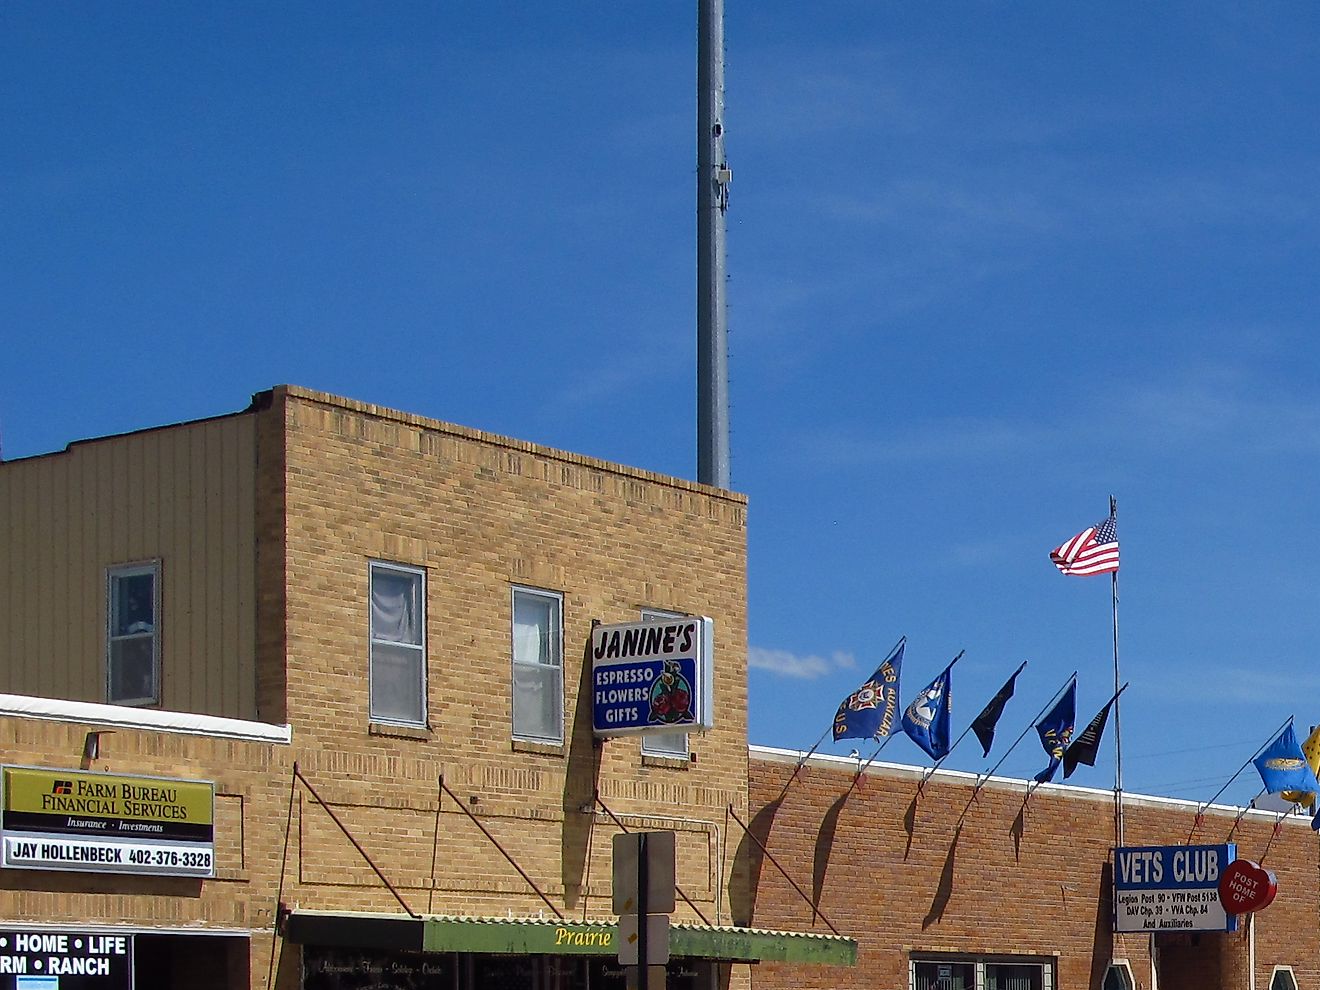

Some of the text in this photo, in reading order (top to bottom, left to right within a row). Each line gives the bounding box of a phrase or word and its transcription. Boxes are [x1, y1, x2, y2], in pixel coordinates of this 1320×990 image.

[595, 624, 695, 659] JANINE'S
[596, 668, 654, 686] ESPRESSO
[596, 687, 649, 704] FLOWERS
[606, 707, 638, 723] GIFTS
[78, 780, 117, 799] FARM
[122, 783, 177, 803] BUREAU
[42, 794, 187, 820] FINANCIAL SERVICES
[66, 816, 164, 833] Insurance Investments
[13, 842, 211, 868] JAY HOLLENBECK 402-376-3328
[1120, 850, 1219, 884] VETS CLUB
[1230, 880, 1256, 899] HOME
[1234, 871, 1259, 890] POST
[1118, 894, 1138, 906] Legion
[1141, 894, 1155, 904] Post
[1158, 893, 1166, 902] 90
[1172, 893, 1186, 903] VFW
[1186, 892, 1200, 902] Post
[1232, 892, 1246, 903] OF
[1126, 906, 1139, 916] DAV
[1140, 905, 1154, 918] Chp.
[1172, 905, 1184, 914] VVA
[1186, 904, 1199, 916] Chp.
[1143, 918, 1193, 928] And Auxiliaries
[16, 934, 126, 954] HOME LIFE
[555, 928, 612, 946] Prairie
[48, 957, 110, 976] RANCH
